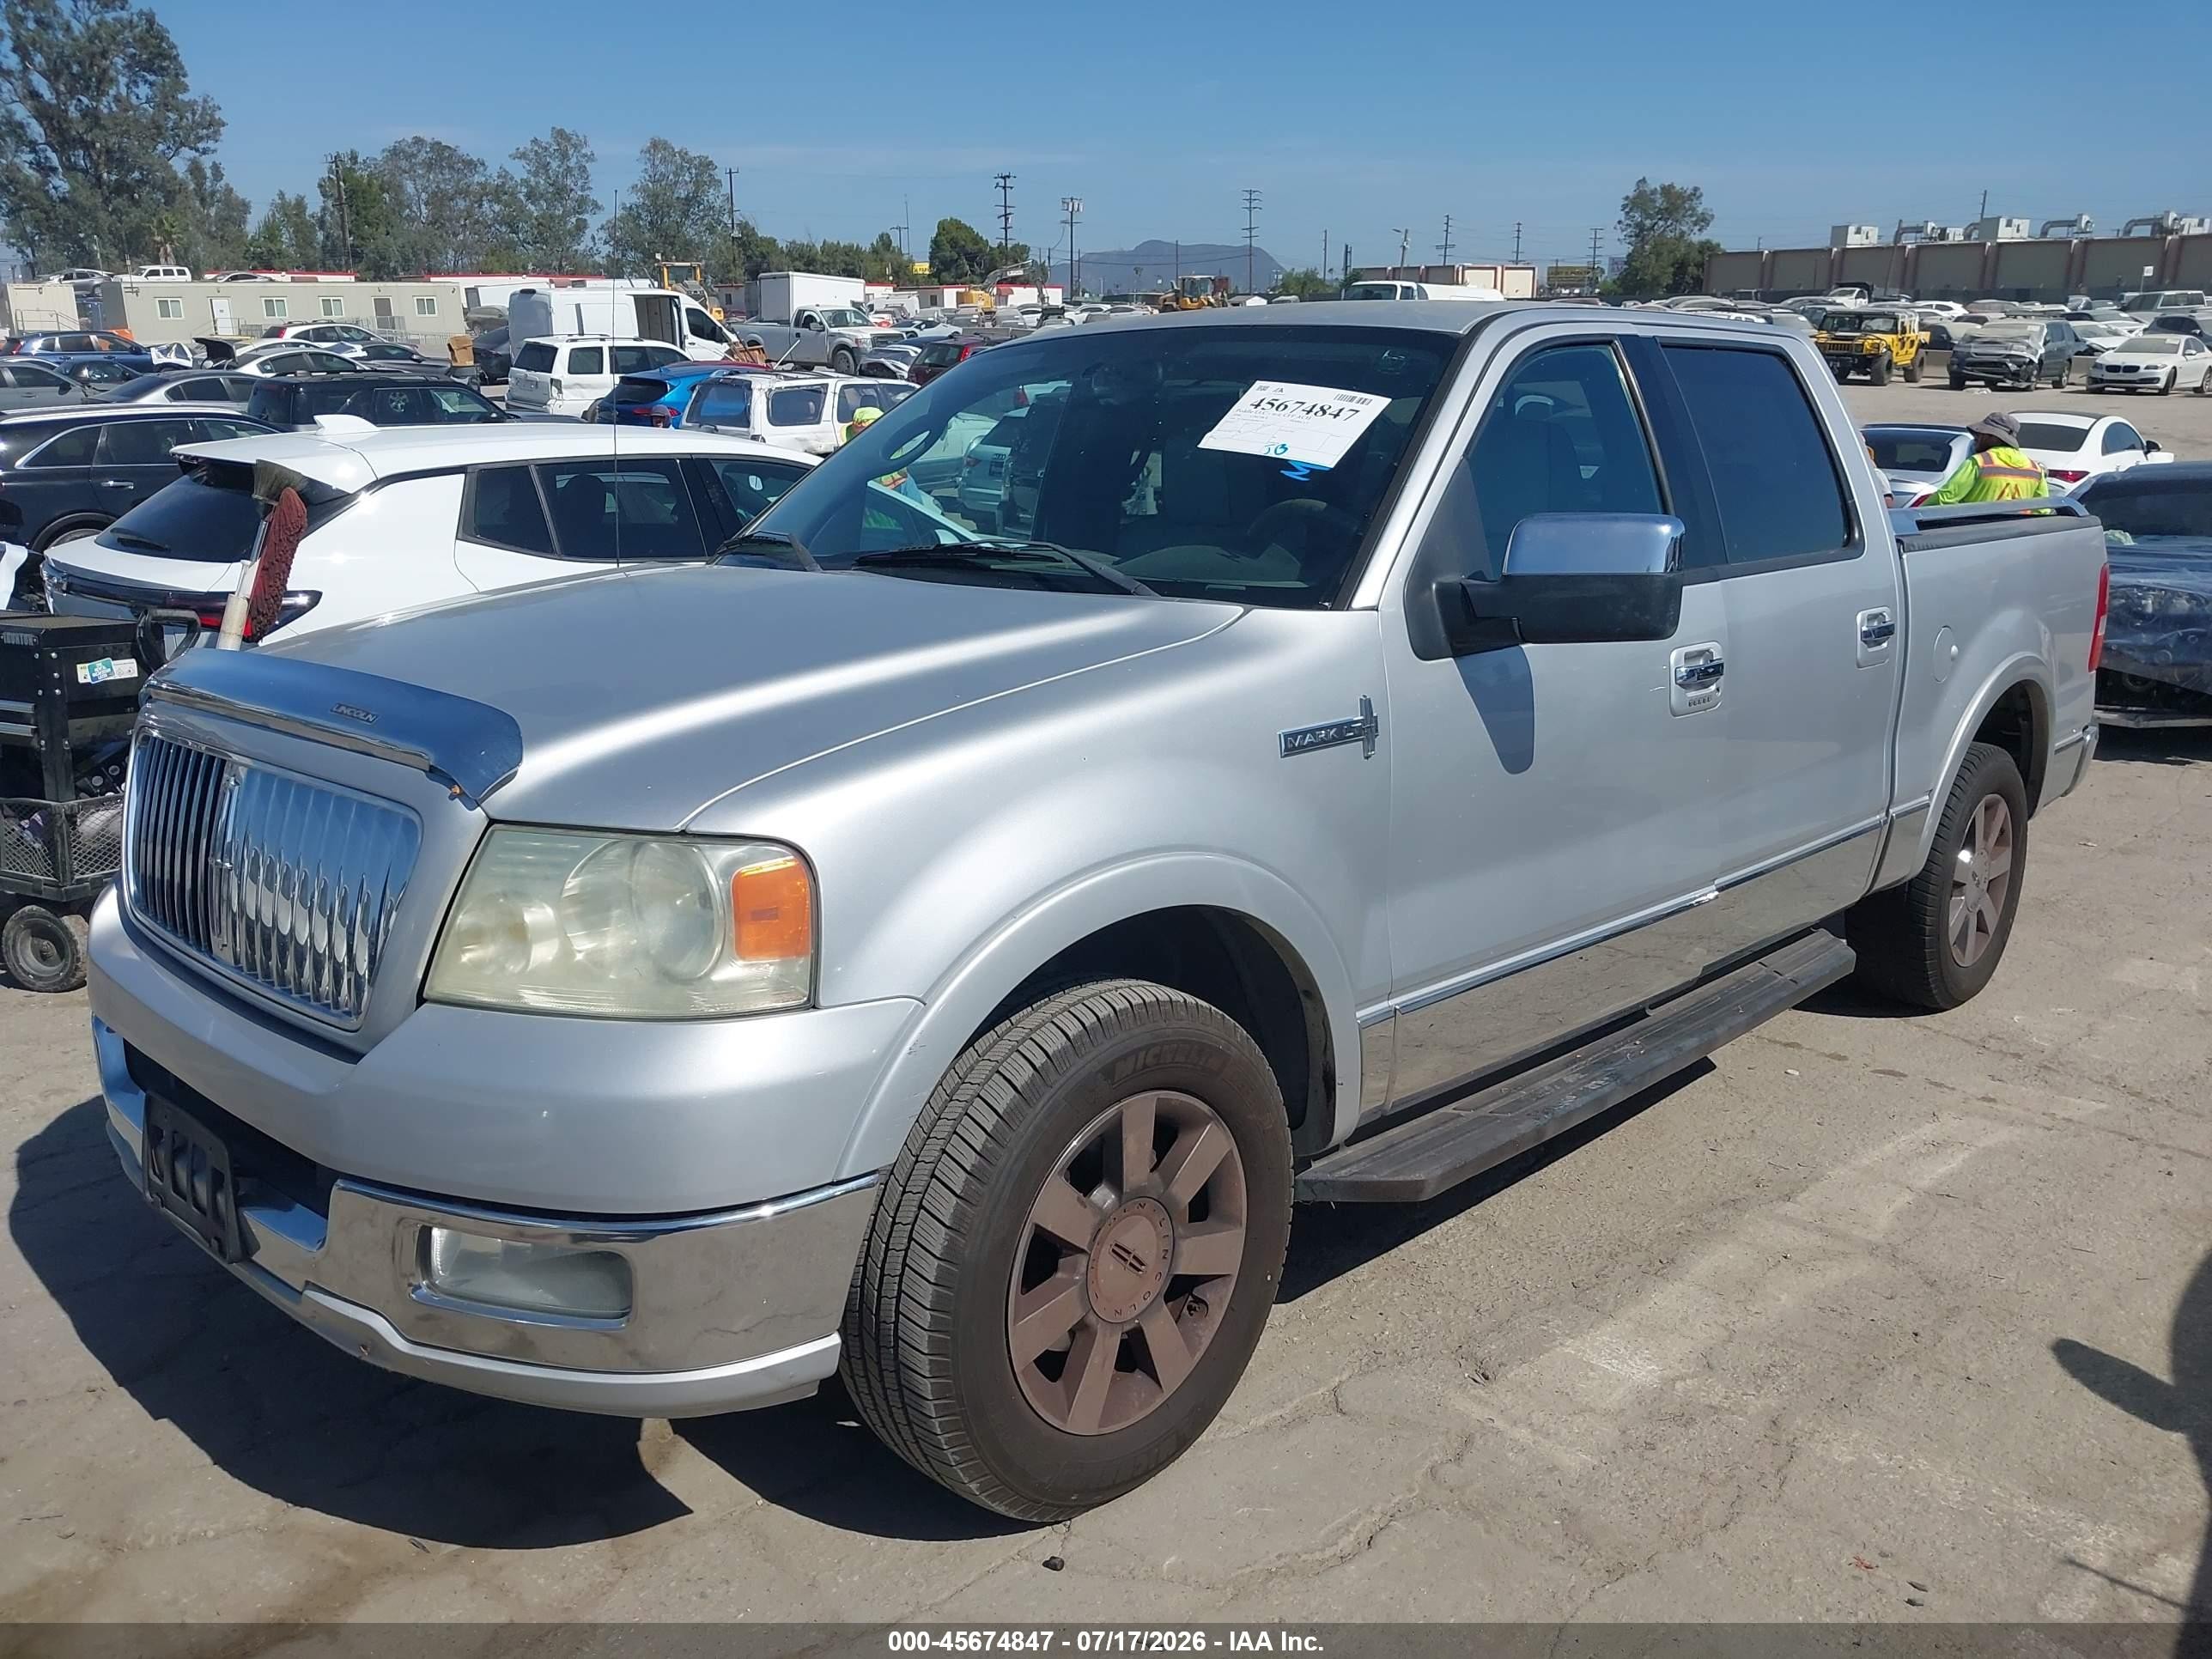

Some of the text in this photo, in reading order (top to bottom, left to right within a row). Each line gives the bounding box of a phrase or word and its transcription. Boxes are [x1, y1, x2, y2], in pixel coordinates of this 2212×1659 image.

[1250, 397, 1360, 422] 45674847
[332, 704, 378, 723] LINCOLN
[1287, 727, 1339, 749] MARK
